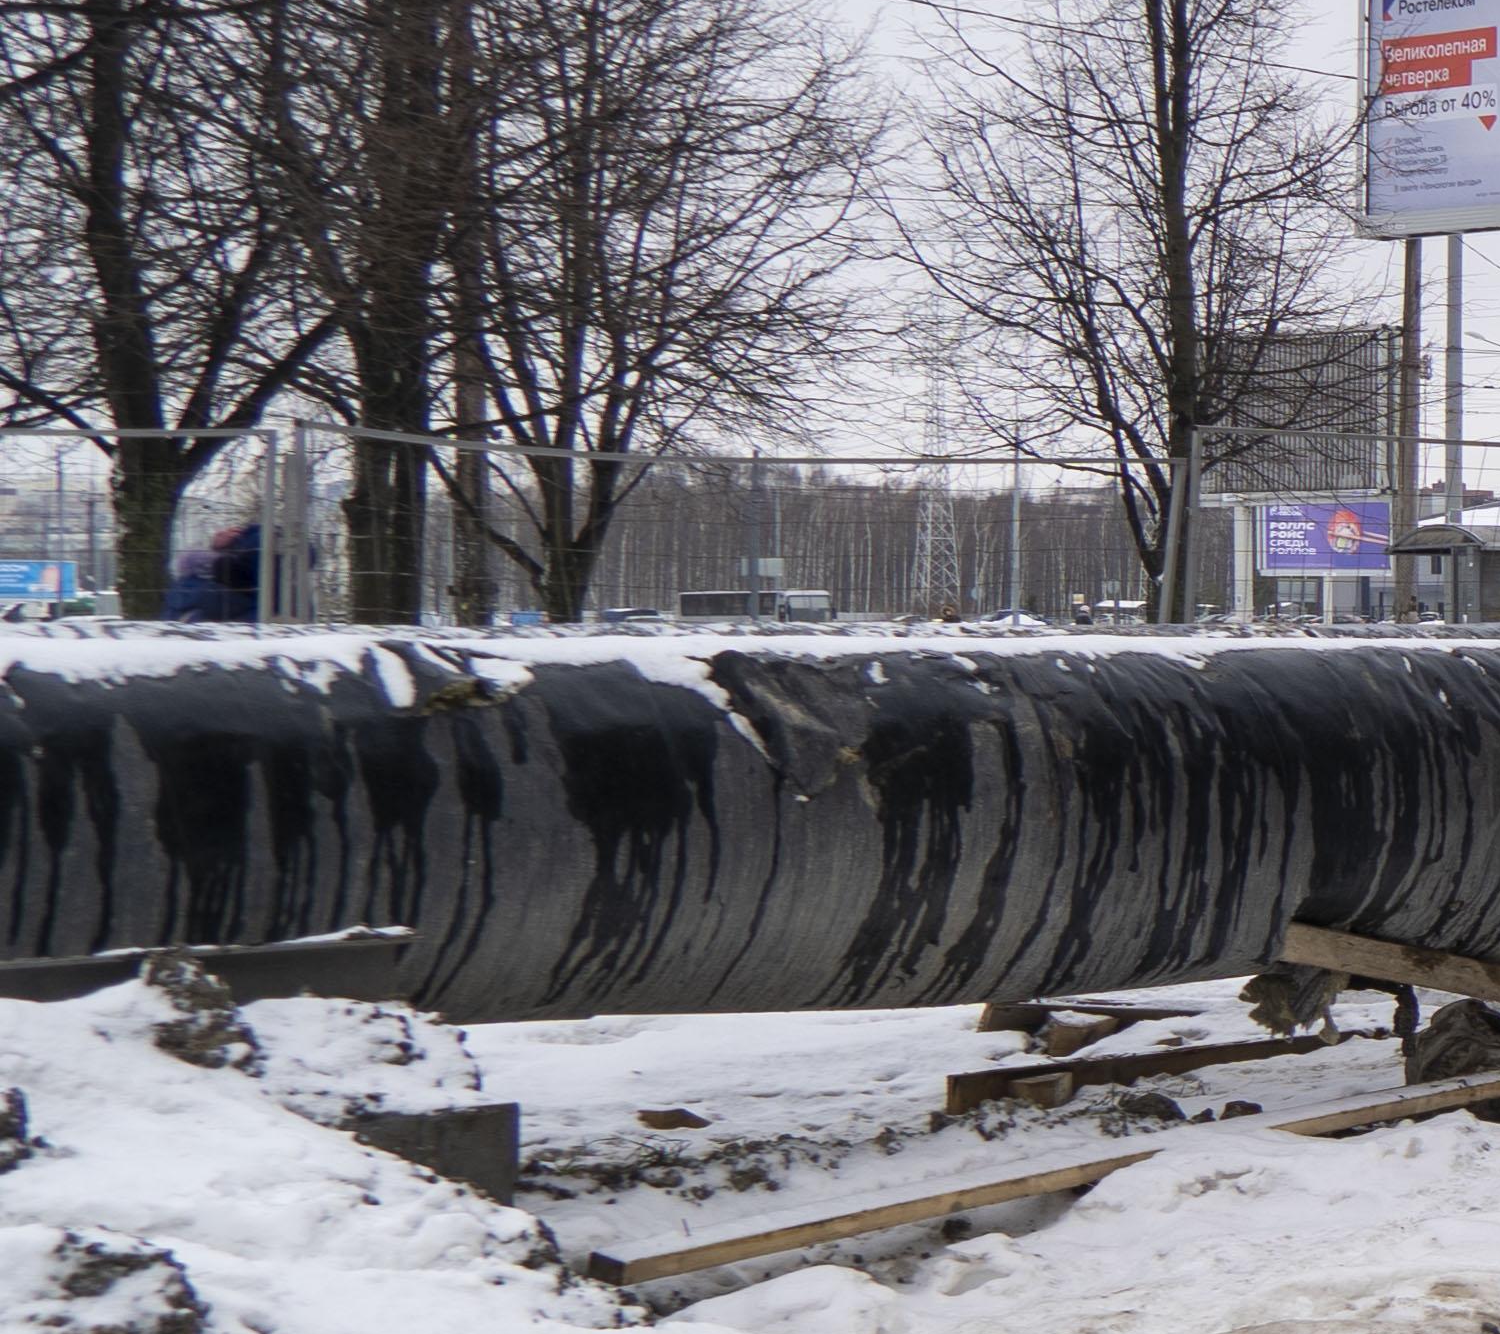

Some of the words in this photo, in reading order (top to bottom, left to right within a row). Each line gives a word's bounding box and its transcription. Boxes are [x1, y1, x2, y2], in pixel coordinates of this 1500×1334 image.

[1385, 38, 1487, 62] Великолепная
[1385, 67, 1450, 87] четверка
[1442, 98, 1457, 112] от
[1461, 90, 1496, 110] 40%
[1270, 522, 1316, 530] РОЛЛС
[1270, 530, 1305, 538] РОЙС
[1270, 539, 1309, 547] СРЕДИ
